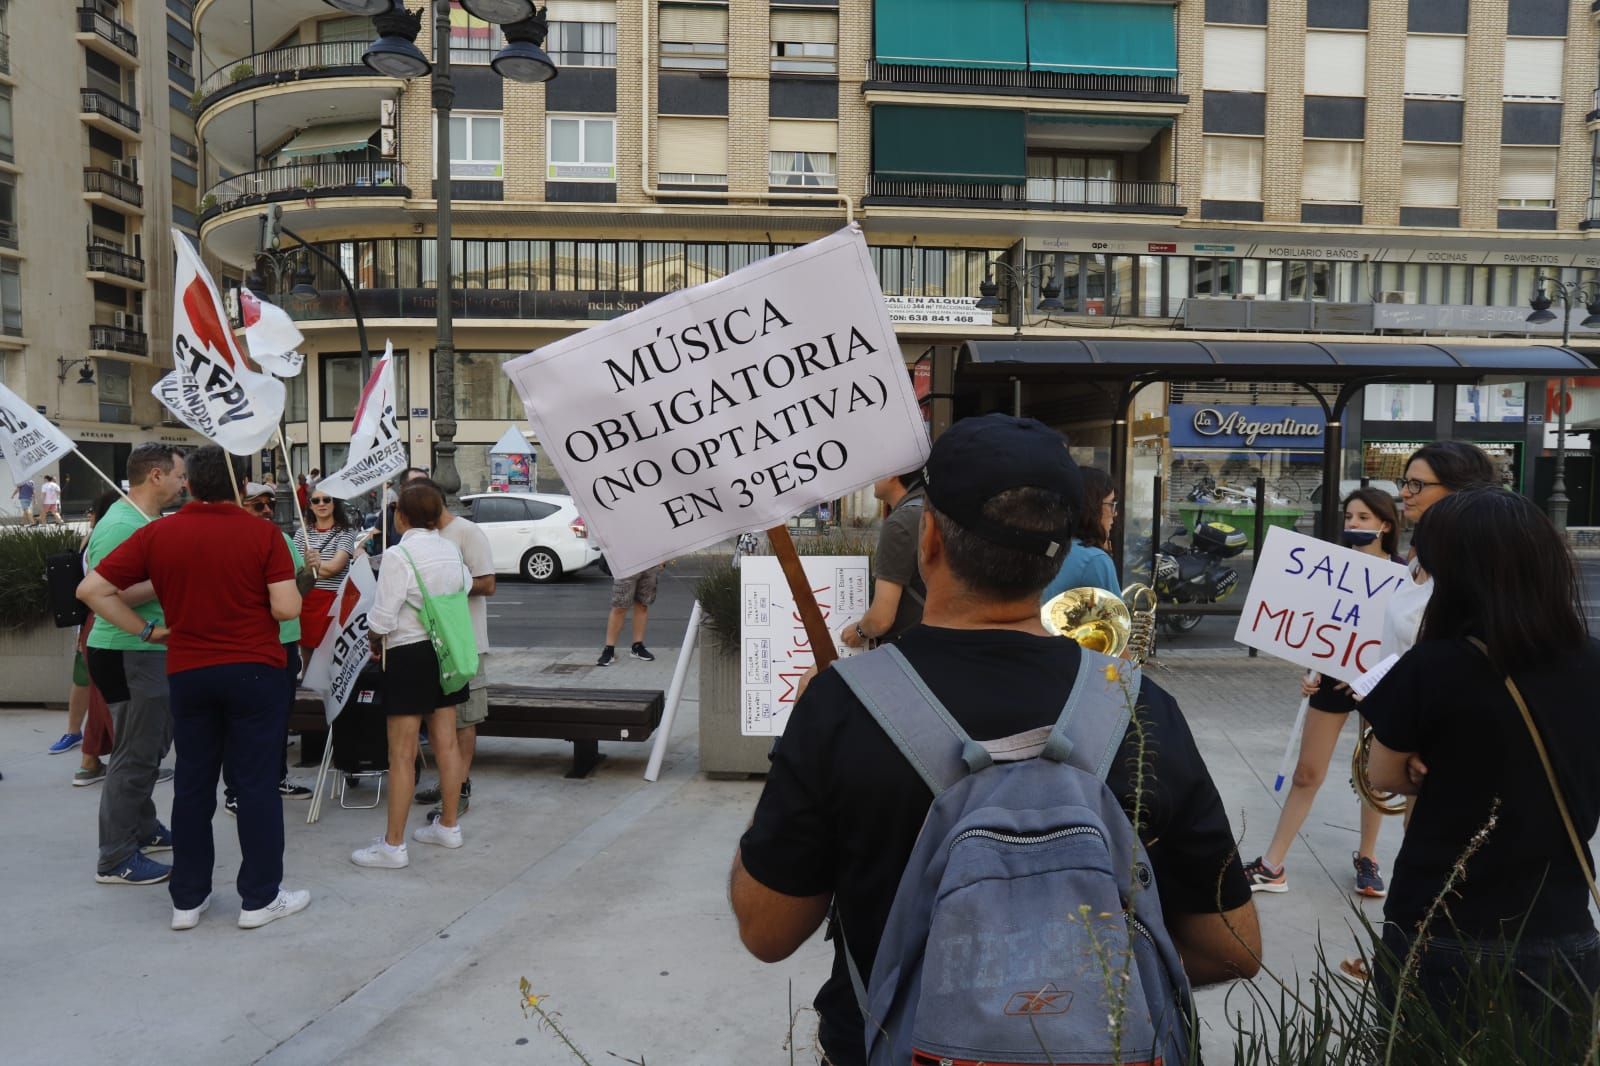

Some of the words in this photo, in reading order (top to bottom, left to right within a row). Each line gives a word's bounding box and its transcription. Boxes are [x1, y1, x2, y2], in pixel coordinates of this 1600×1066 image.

[1268, 247, 1322, 258] MOBILIARIO
[1326, 247, 1359, 259] BAÑOS
[1427, 252, 1468, 262] COCINAS
[1503, 254, 1559, 264] PAVIMENTOS
[617, 300, 638, 311] San
[603, 298, 792, 393] MÚSICA
[175, 333, 254, 426] STEPV
[564, 325, 878, 463] OBLIGATORIA
[592, 459, 663, 511] (NO
[670, 374, 888, 475] OPTATIVA)
[1218, 411, 1324, 446] Argentina
[661, 487, 723, 530] EN
[730, 439, 849, 509] 3ºESO
[1331, 599, 1361, 627] LA
